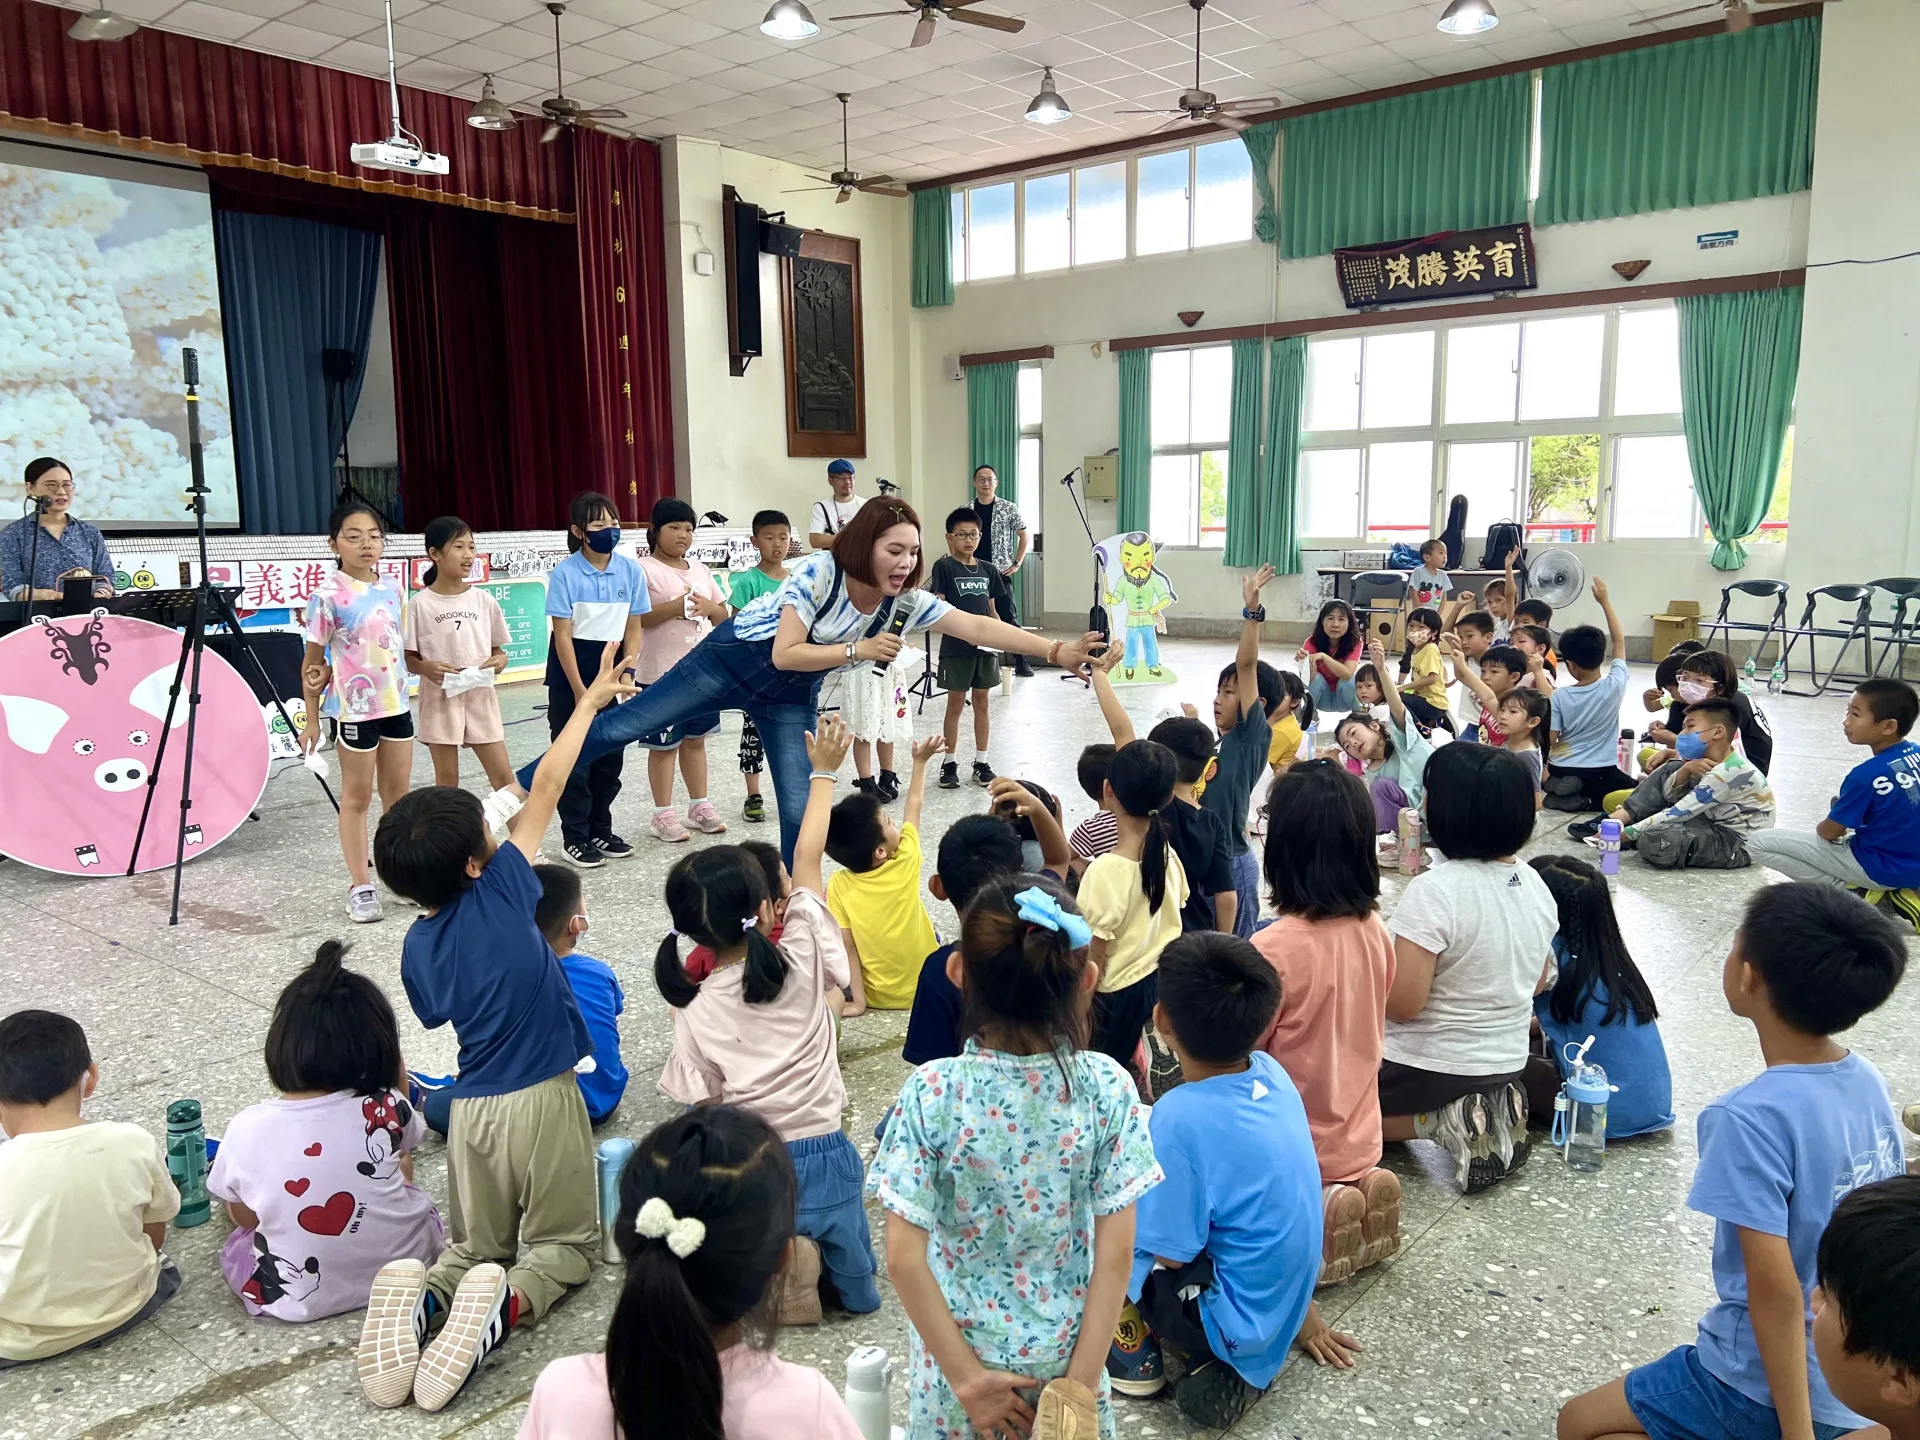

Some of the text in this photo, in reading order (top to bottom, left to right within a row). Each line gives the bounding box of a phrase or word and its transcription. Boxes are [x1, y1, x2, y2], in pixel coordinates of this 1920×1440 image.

[434, 610, 479, 624] BROOKLYN
[455, 620, 462, 631] 7
[349, 1202, 368, 1234] Oh my!
